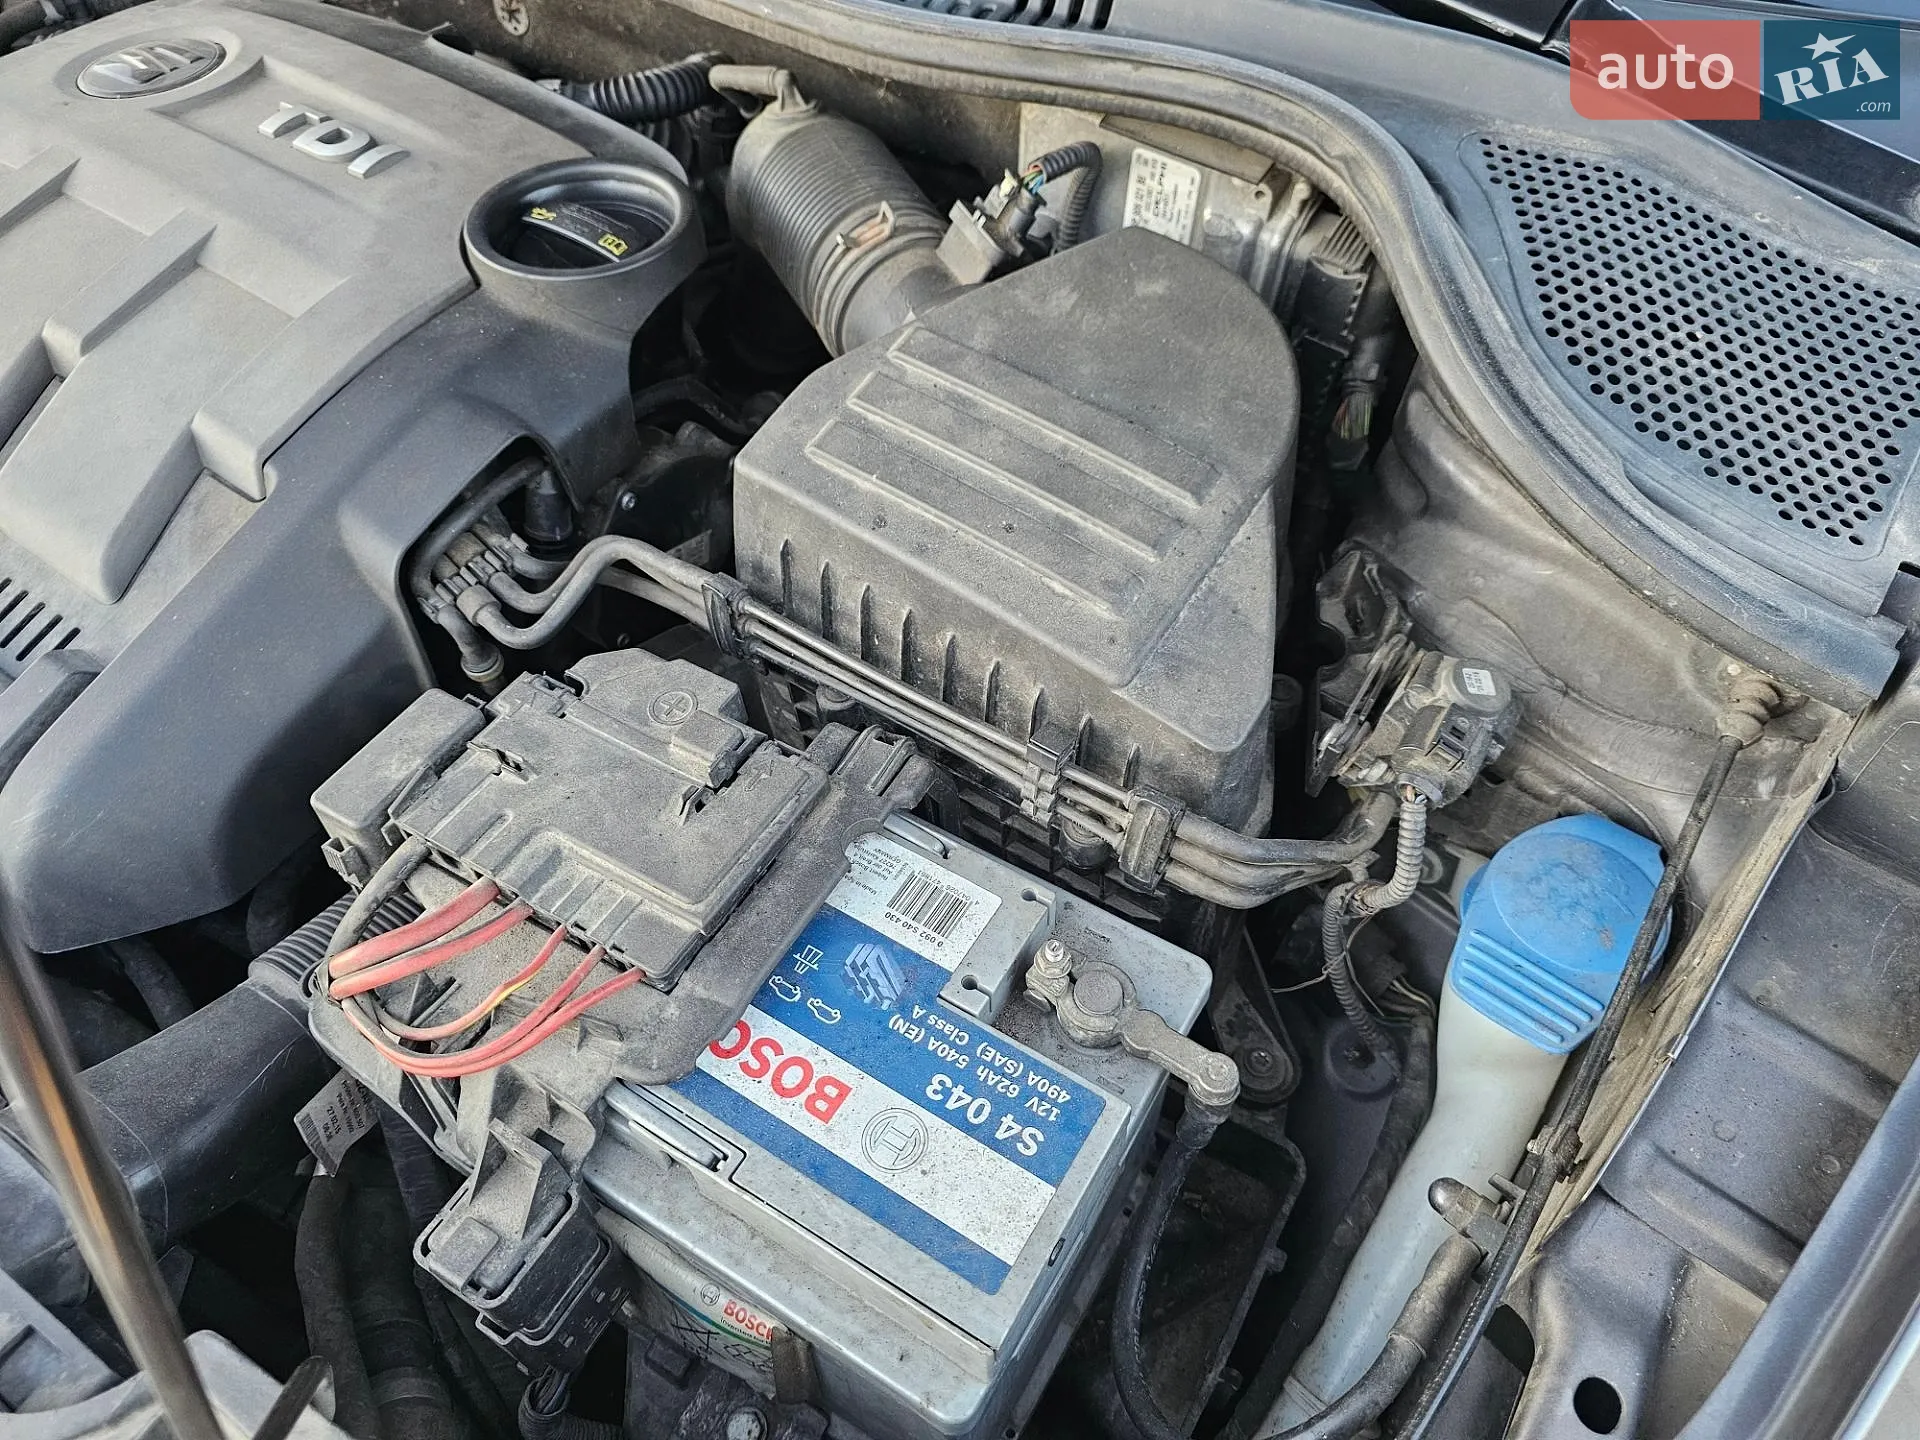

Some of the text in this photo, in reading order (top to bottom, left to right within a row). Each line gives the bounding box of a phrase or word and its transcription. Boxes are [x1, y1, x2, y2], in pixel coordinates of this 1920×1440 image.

[258, 101, 410, 179] TDI
[885, 912, 901, 923] 430
[902, 922, 919, 933] S40
[920, 931, 936, 943] 092
[708, 1020, 853, 1124] BOSC
[889, 1014, 1060, 1123] 12V 62Ah 540A (EN)
[913, 1005, 1071, 1103] 490A (SAE) Class A
[926, 1073, 1044, 1156] S4 043
